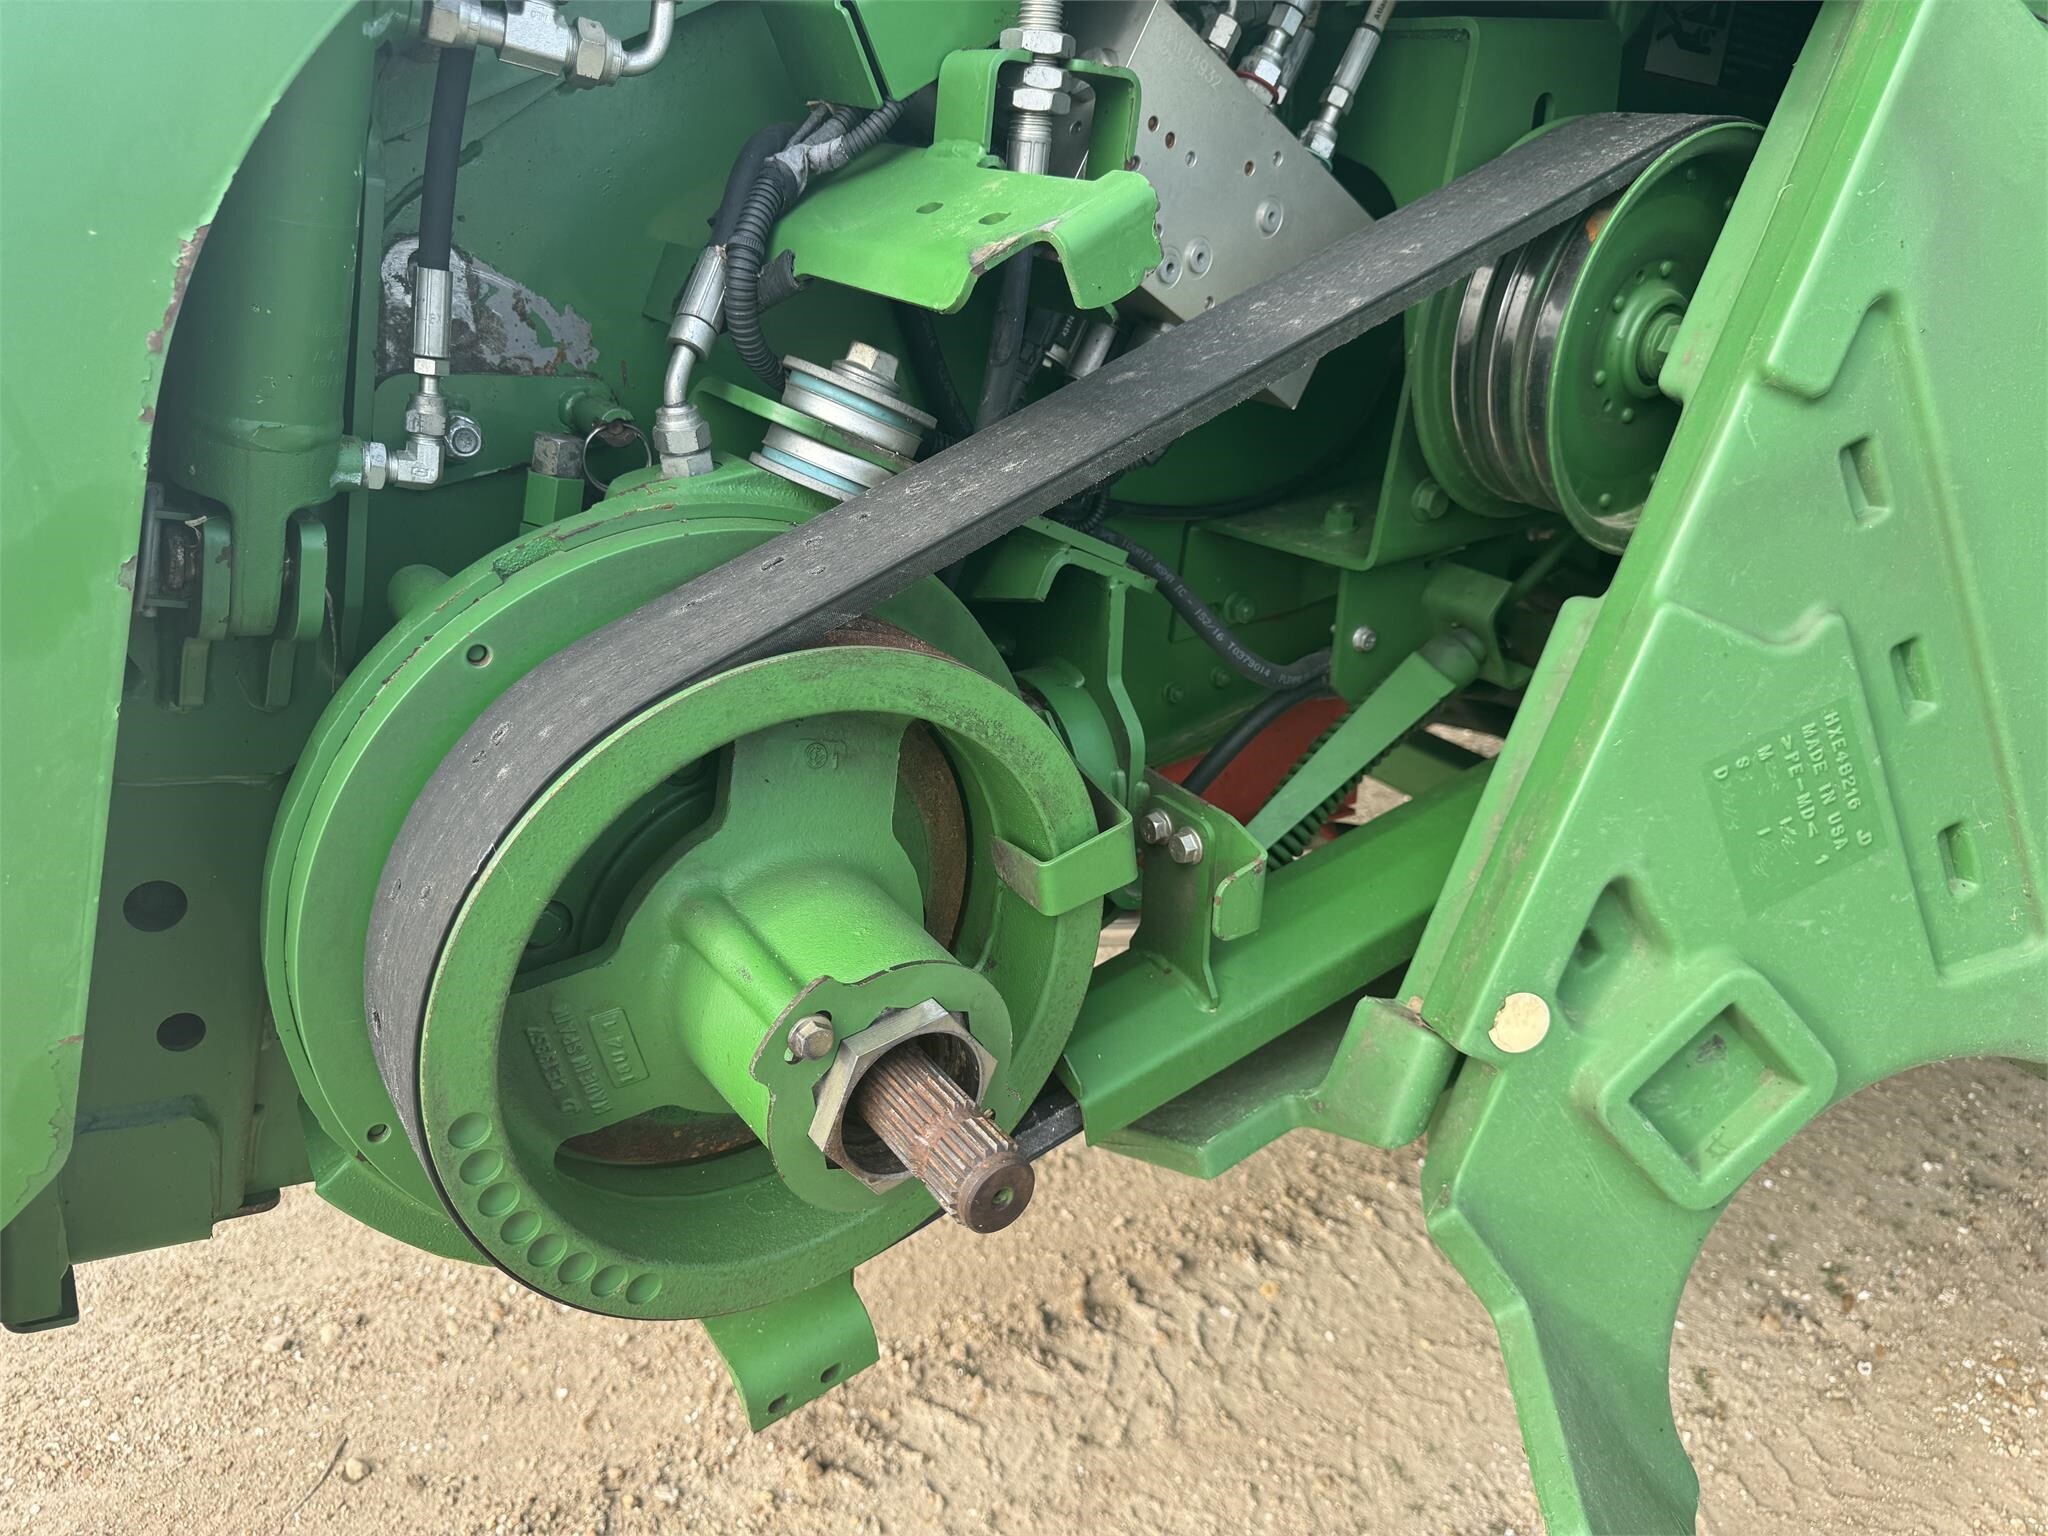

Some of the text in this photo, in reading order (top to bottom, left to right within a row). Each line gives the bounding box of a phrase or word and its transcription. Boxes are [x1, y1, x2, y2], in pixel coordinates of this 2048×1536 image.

[1227, 641, 1271, 677] T0379014
[1802, 722, 1849, 850] MADE IN USA
[1824, 710, 1862, 811] HXE48216
[578, 1073, 613, 1115] MADE
